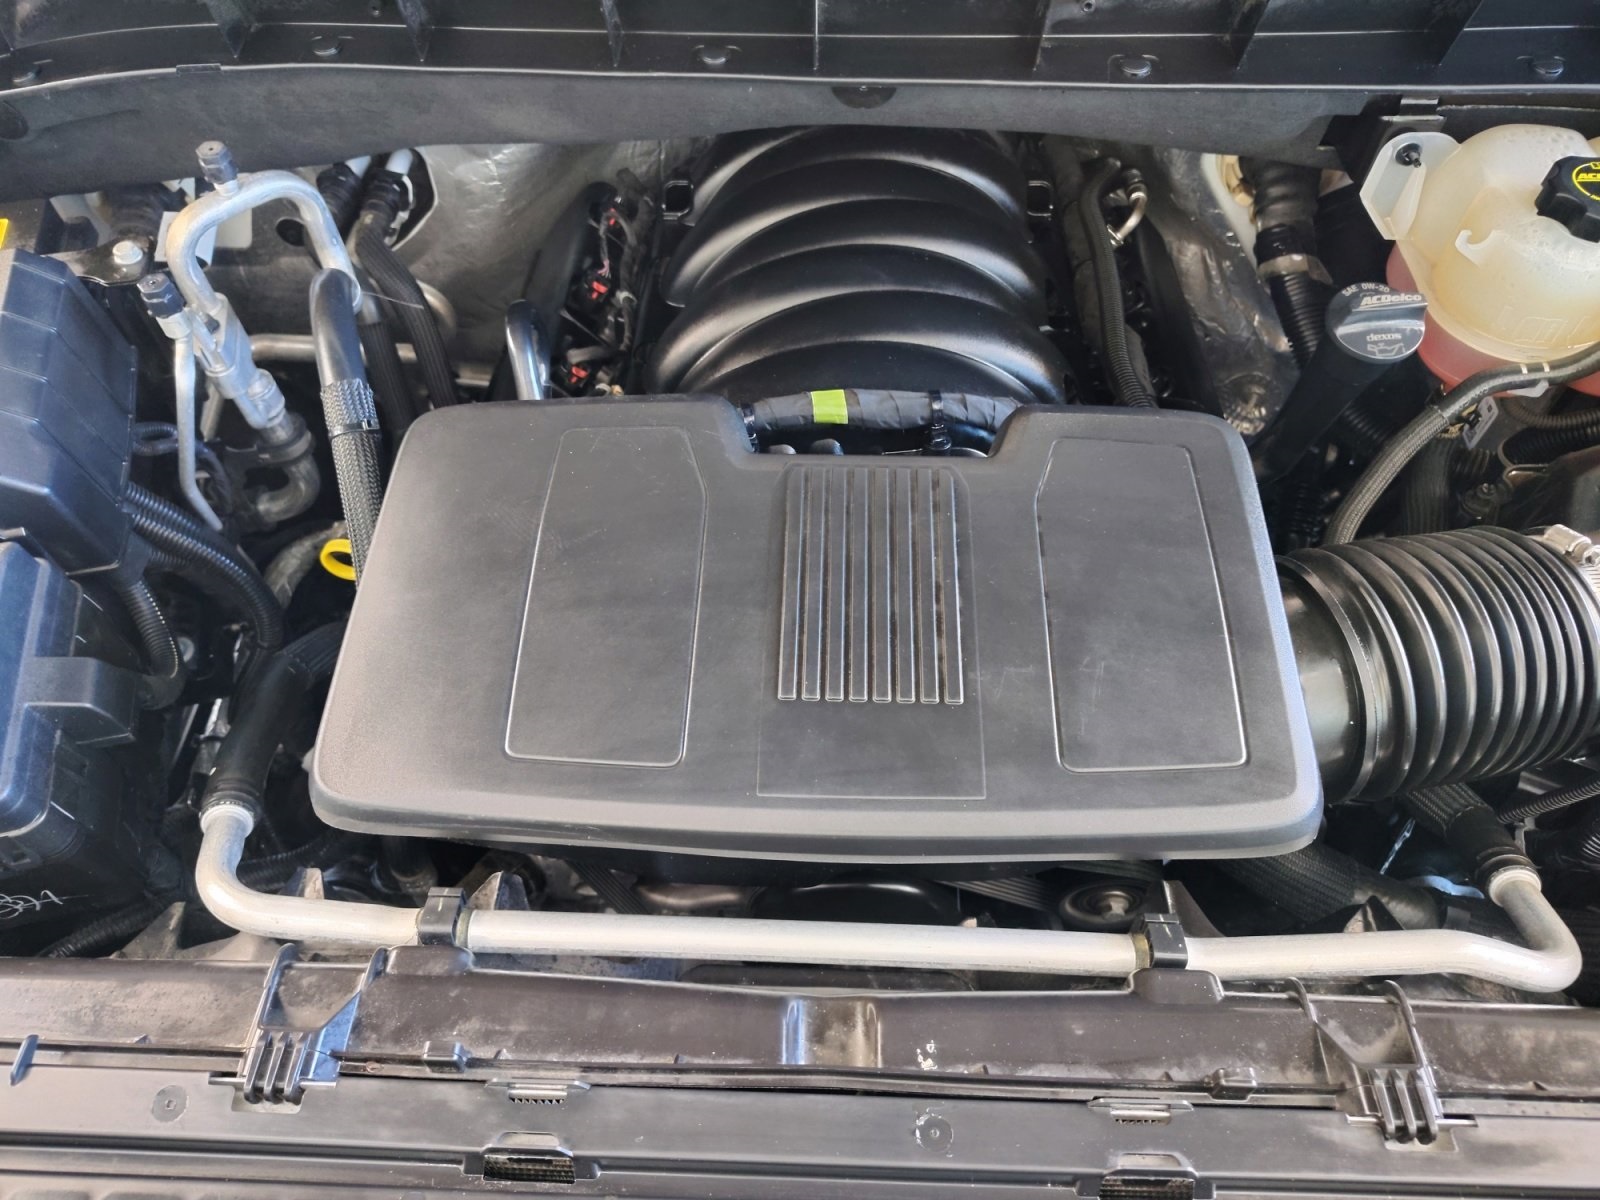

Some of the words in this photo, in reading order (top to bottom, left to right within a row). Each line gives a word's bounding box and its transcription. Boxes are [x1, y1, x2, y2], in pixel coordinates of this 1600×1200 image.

[1342, 284, 1359, 297] SAE
[1361, 282, 1390, 293] 0W-20
[1360, 293, 1422, 306] ACDelco
[1366, 333, 1402, 342] dexos
